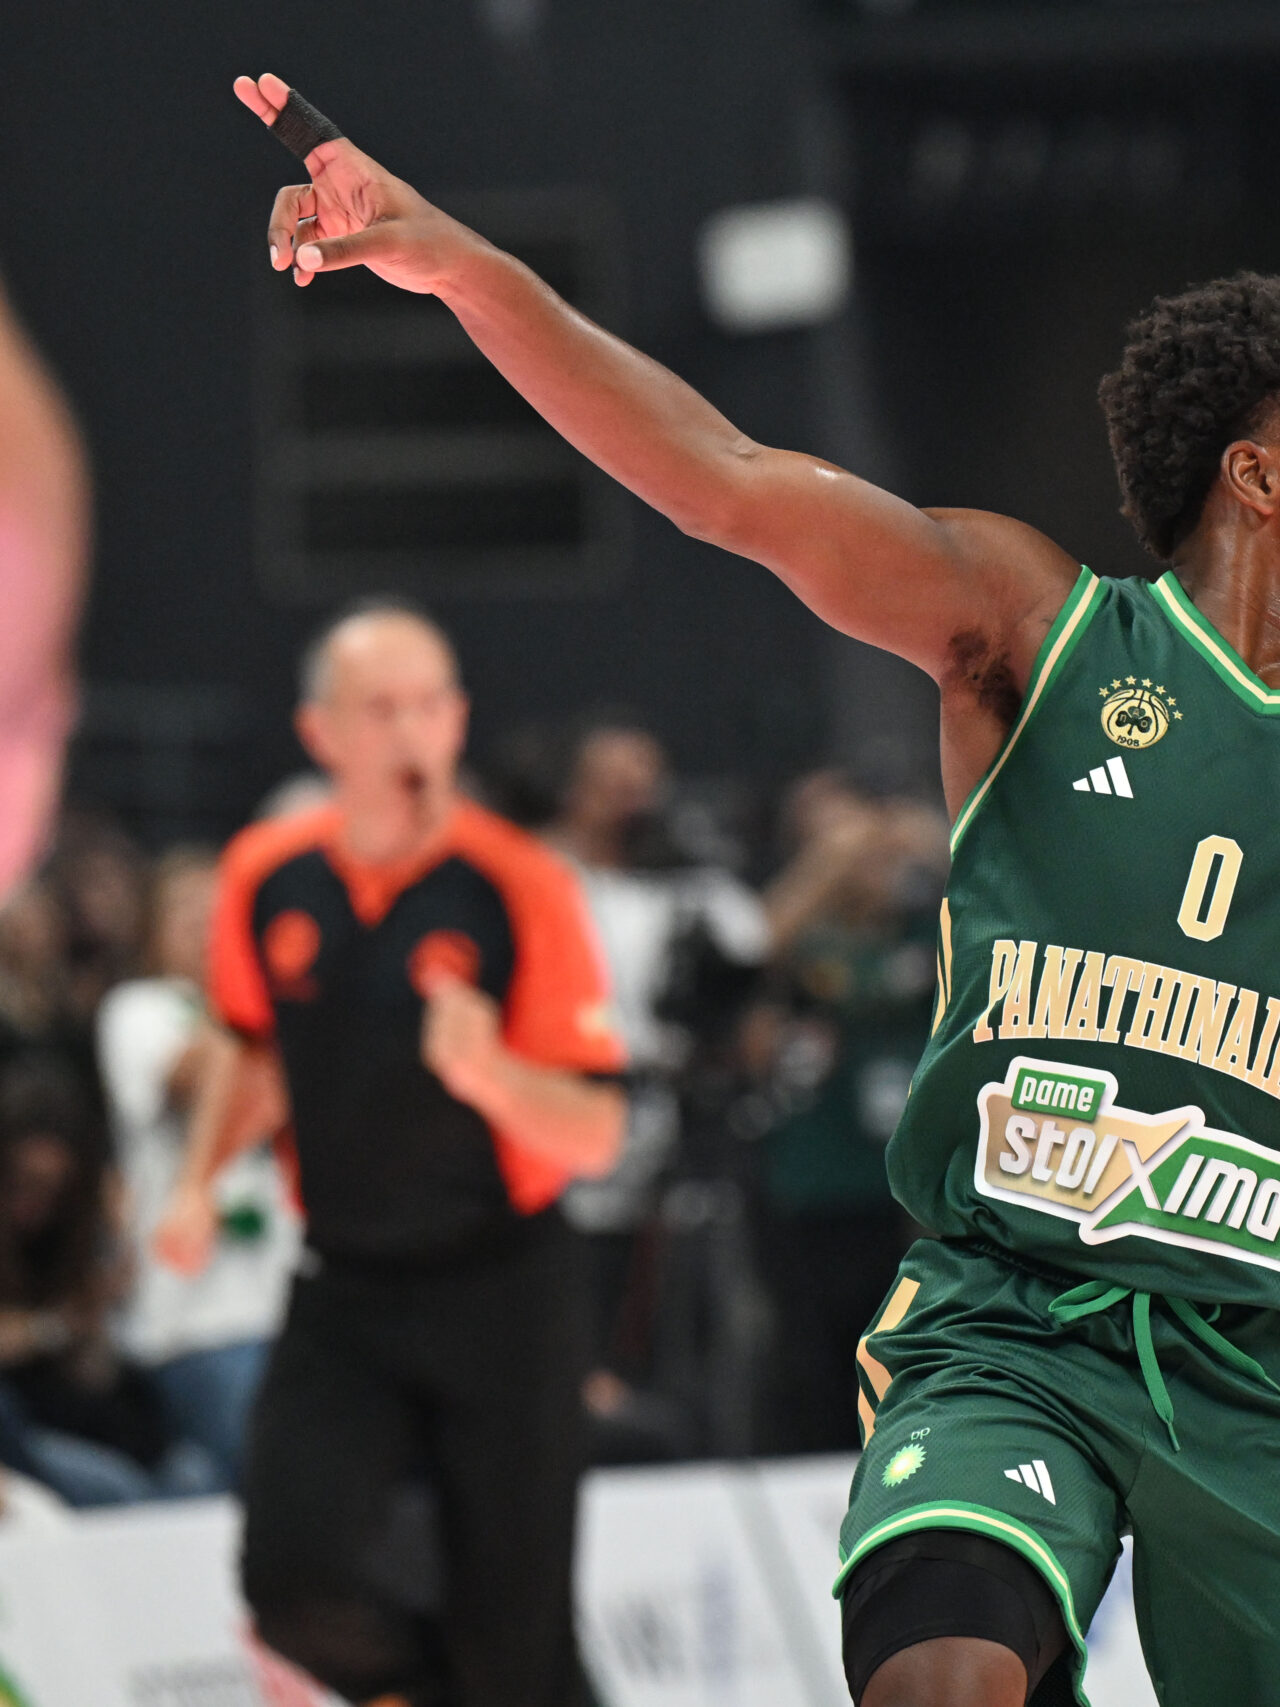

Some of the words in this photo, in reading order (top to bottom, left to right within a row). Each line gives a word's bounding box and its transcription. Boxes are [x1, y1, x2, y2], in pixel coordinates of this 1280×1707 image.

[1117, 735, 1140, 747] 1908
[1177, 835, 1244, 942] 0
[1018, 1075, 1095, 1112] pame
